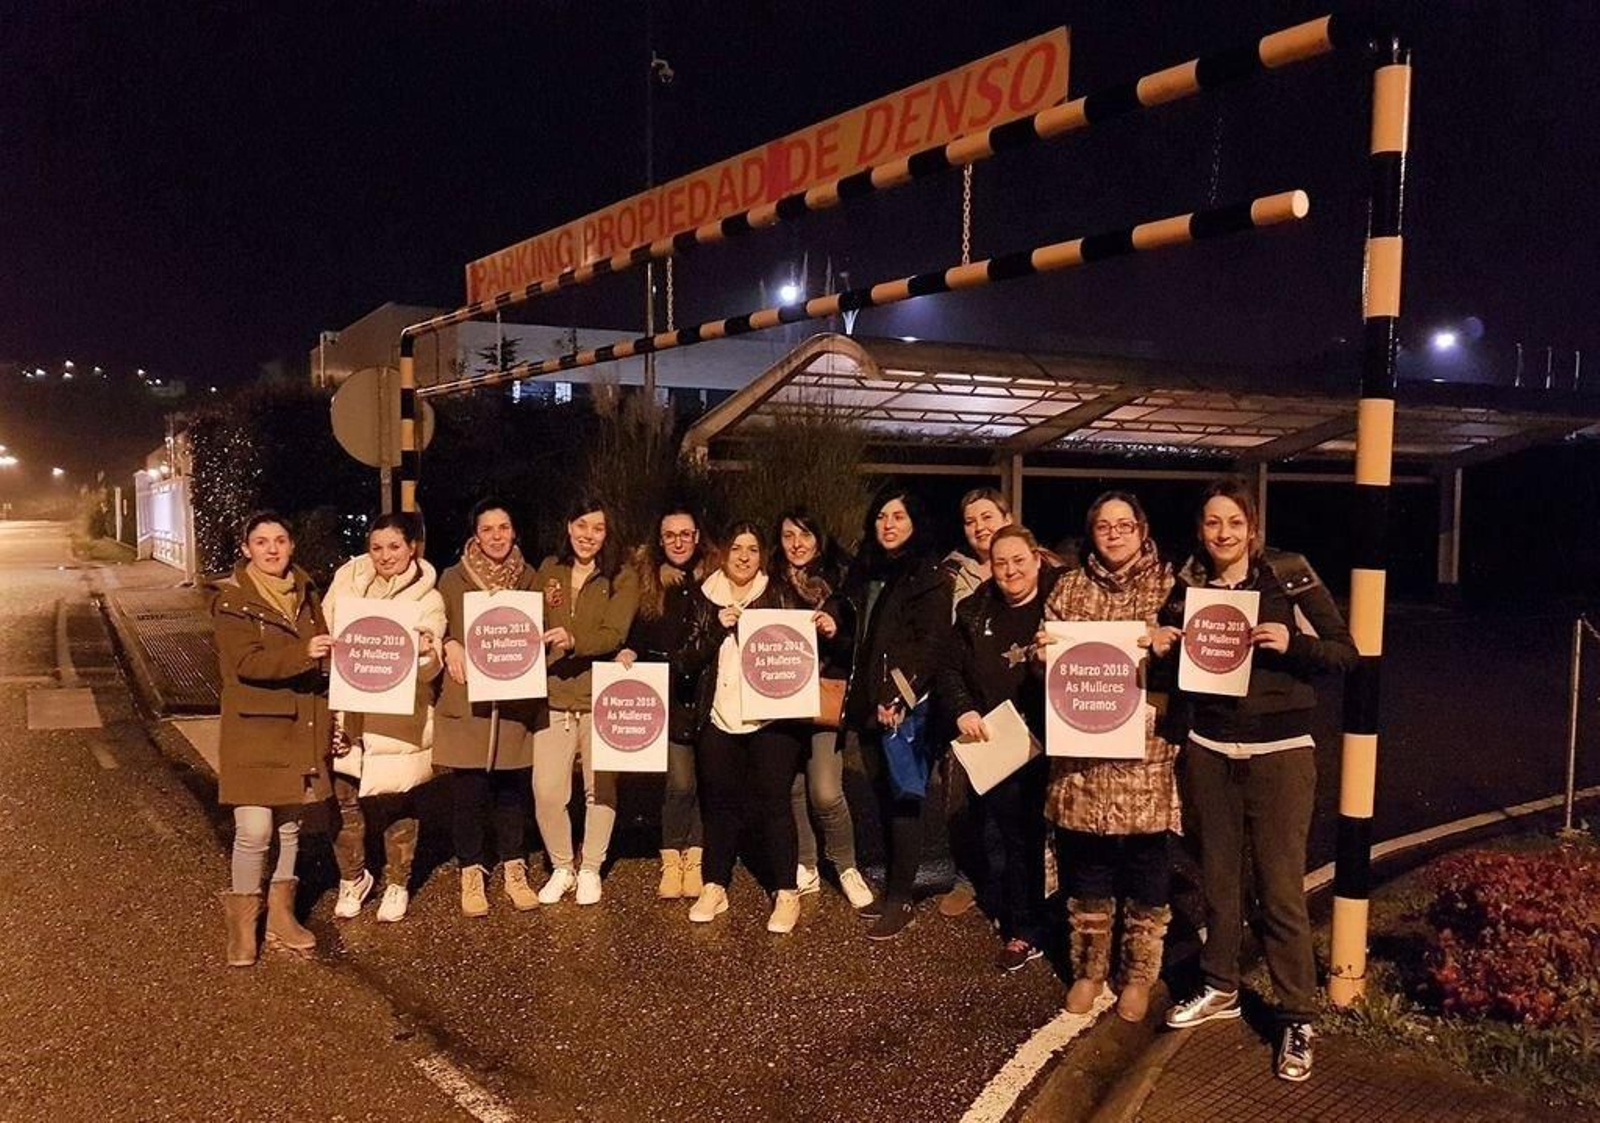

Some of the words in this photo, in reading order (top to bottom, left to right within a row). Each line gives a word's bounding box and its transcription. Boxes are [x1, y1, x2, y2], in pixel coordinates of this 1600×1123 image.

[469, 229, 575, 297] PARKING
[583, 157, 764, 262] PROPIEDAD
[780, 122, 839, 190] DE
[856, 40, 1058, 165] DENSO
[475, 626, 481, 636] 8
[483, 625, 508, 635] Marzo
[509, 623, 530, 633] 2018
[1194, 619, 1200, 628] 8
[1201, 619, 1226, 630] Marzo
[1227, 621, 1245, 632] 2018
[344, 633, 352, 644] 8
[354, 634, 381, 645] Marzo
[382, 635, 405, 646] 2018
[480, 639, 491, 649] As
[493, 638, 527, 649] Mulleres
[1197, 633, 1207, 642] As
[1209, 634, 1240, 645] Mulleres
[757, 642, 782, 652] Marzo
[1200, 646, 1235, 658] Paramos
[348, 648, 361, 658] As
[362, 649, 400, 660] Mulleres
[486, 653, 523, 663] Paramos
[755, 657, 766, 667] As
[766, 655, 801, 665] Mulleres
[354, 663, 393, 674] Paramos
[1060, 664, 1067, 676] 8
[1069, 664, 1100, 676] Marzo
[1103, 664, 1130, 676] 2018
[761, 671, 796, 681] Paramos
[1065, 681, 1079, 692] As
[1081, 681, 1125, 693] Mulleres
[602, 697, 608, 706] 8
[610, 697, 634, 706] Marzo
[636, 697, 657, 707] 2018
[1072, 698, 1117, 711] Paramos
[607, 711, 617, 720] As
[618, 711, 652, 721] Mulleres
[611, 725, 646, 735] Paramos
